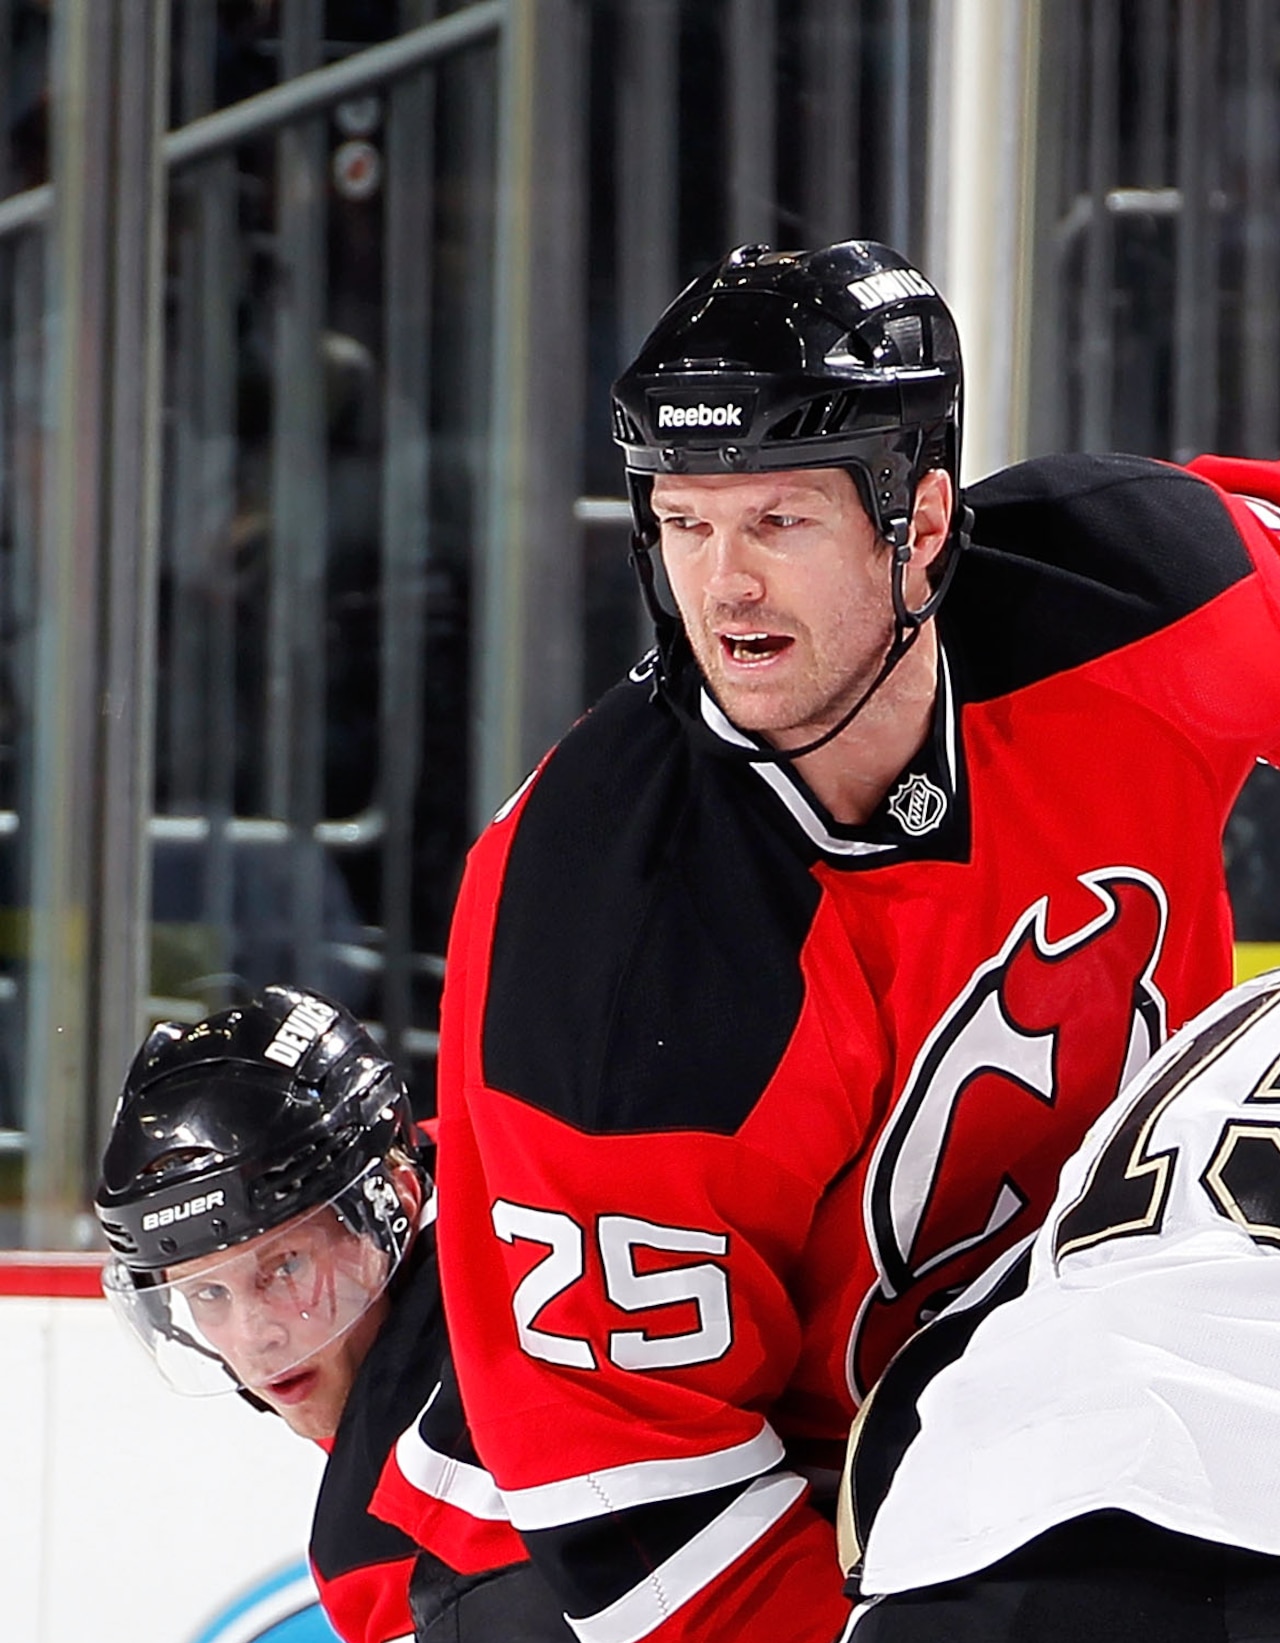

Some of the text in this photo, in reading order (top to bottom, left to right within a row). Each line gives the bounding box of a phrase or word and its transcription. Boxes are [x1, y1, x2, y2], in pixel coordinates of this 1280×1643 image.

[658, 403, 743, 429] Reebok
[264, 996, 339, 1068] DEVILS
[141, 1189, 225, 1232] BAUER
[490, 1197, 734, 1372] 25
